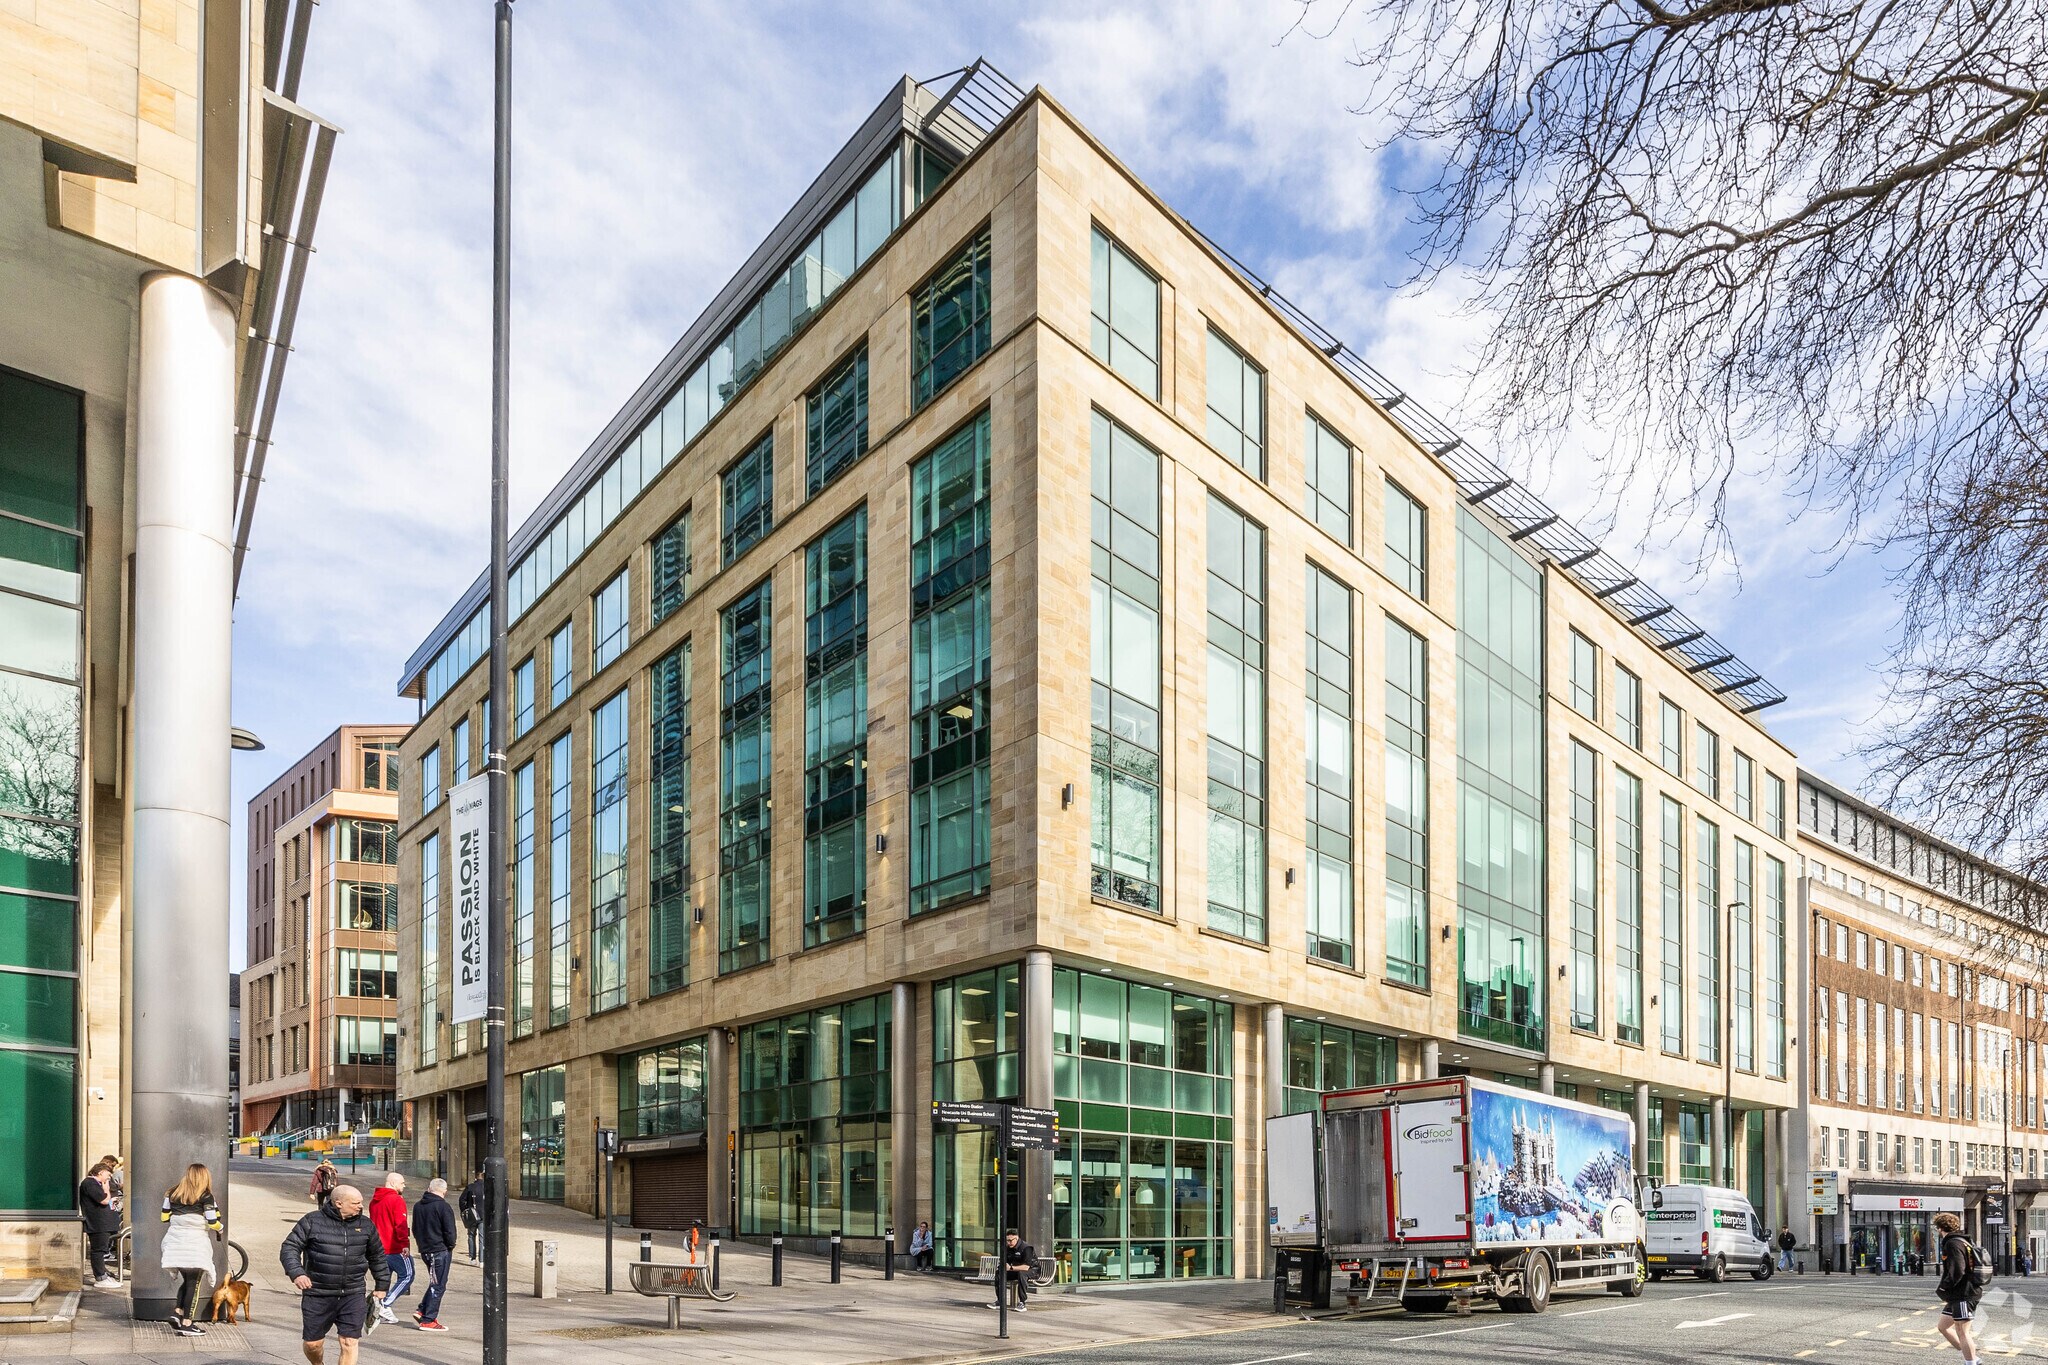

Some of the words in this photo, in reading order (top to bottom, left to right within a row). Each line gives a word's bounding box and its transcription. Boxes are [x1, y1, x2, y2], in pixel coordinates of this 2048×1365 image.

[472, 827, 480, 876] WHITE
[460, 831, 474, 986] PASSION
[475, 968, 481, 982] IS
[1414, 1127, 1453, 1140] Bidfood
[1903, 1199, 1919, 1207] SPAR
[1649, 1212, 1695, 1220] enterprise
[1715, 1213, 1746, 1227] enterprise
